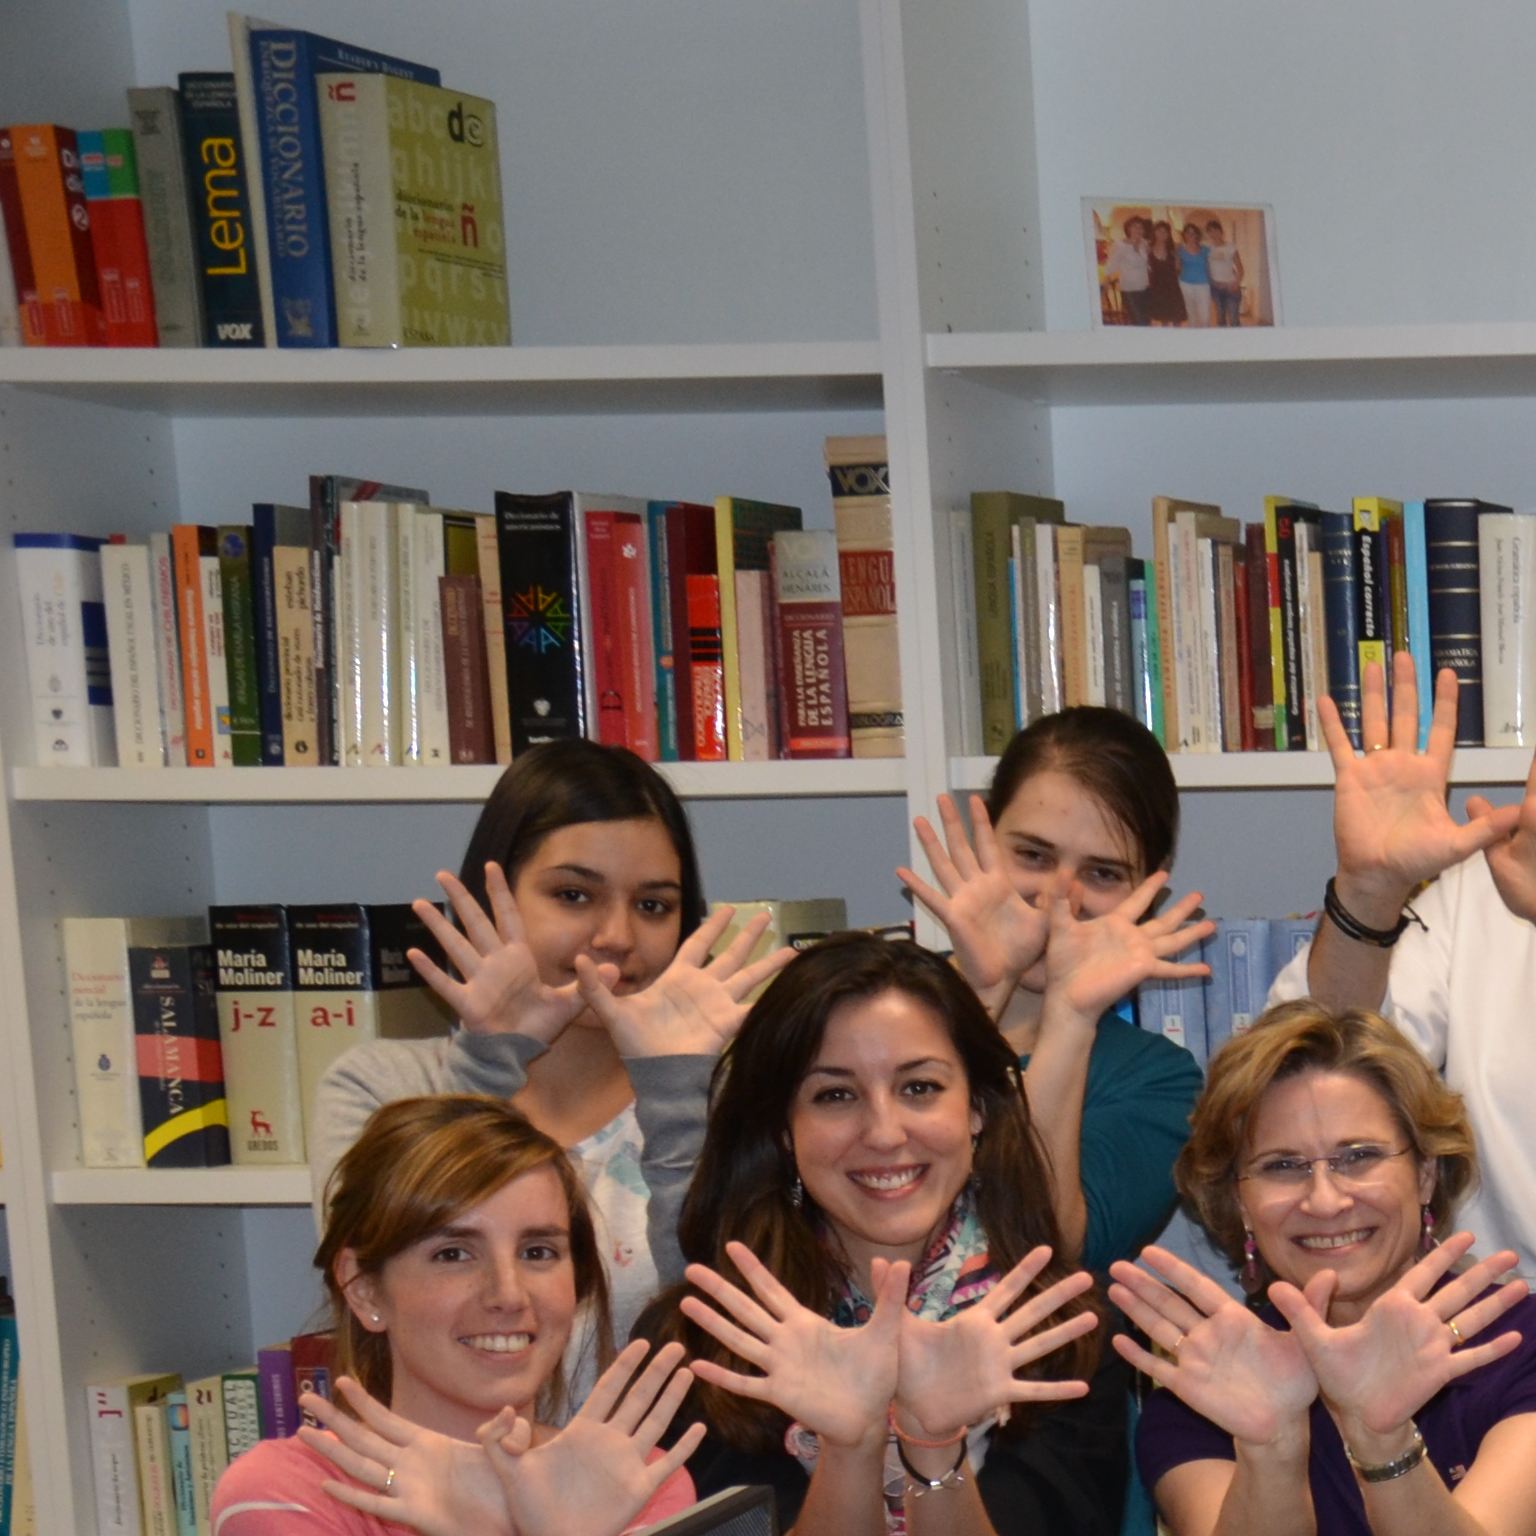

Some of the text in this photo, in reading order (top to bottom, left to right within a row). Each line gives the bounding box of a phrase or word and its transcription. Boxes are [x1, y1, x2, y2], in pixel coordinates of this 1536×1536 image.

[271, 40, 309, 257] DICCIONARIO
[206, 136, 247, 276] Lema
[217, 321, 253, 341] VOX
[1359, 533, 1377, 637] Español correcto
[802, 629, 820, 726] DE LA LENGUA
[813, 628, 834, 726] ESPAÑOLA
[219, 967, 286, 988] Moliner
[298, 967, 365, 987] Moliner
[230, 1000, 278, 1033] j-z
[310, 999, 356, 1028] a-i
[160, 995, 185, 1116] SALAMANCA
[246, 1139, 279, 1151] GREDOS
